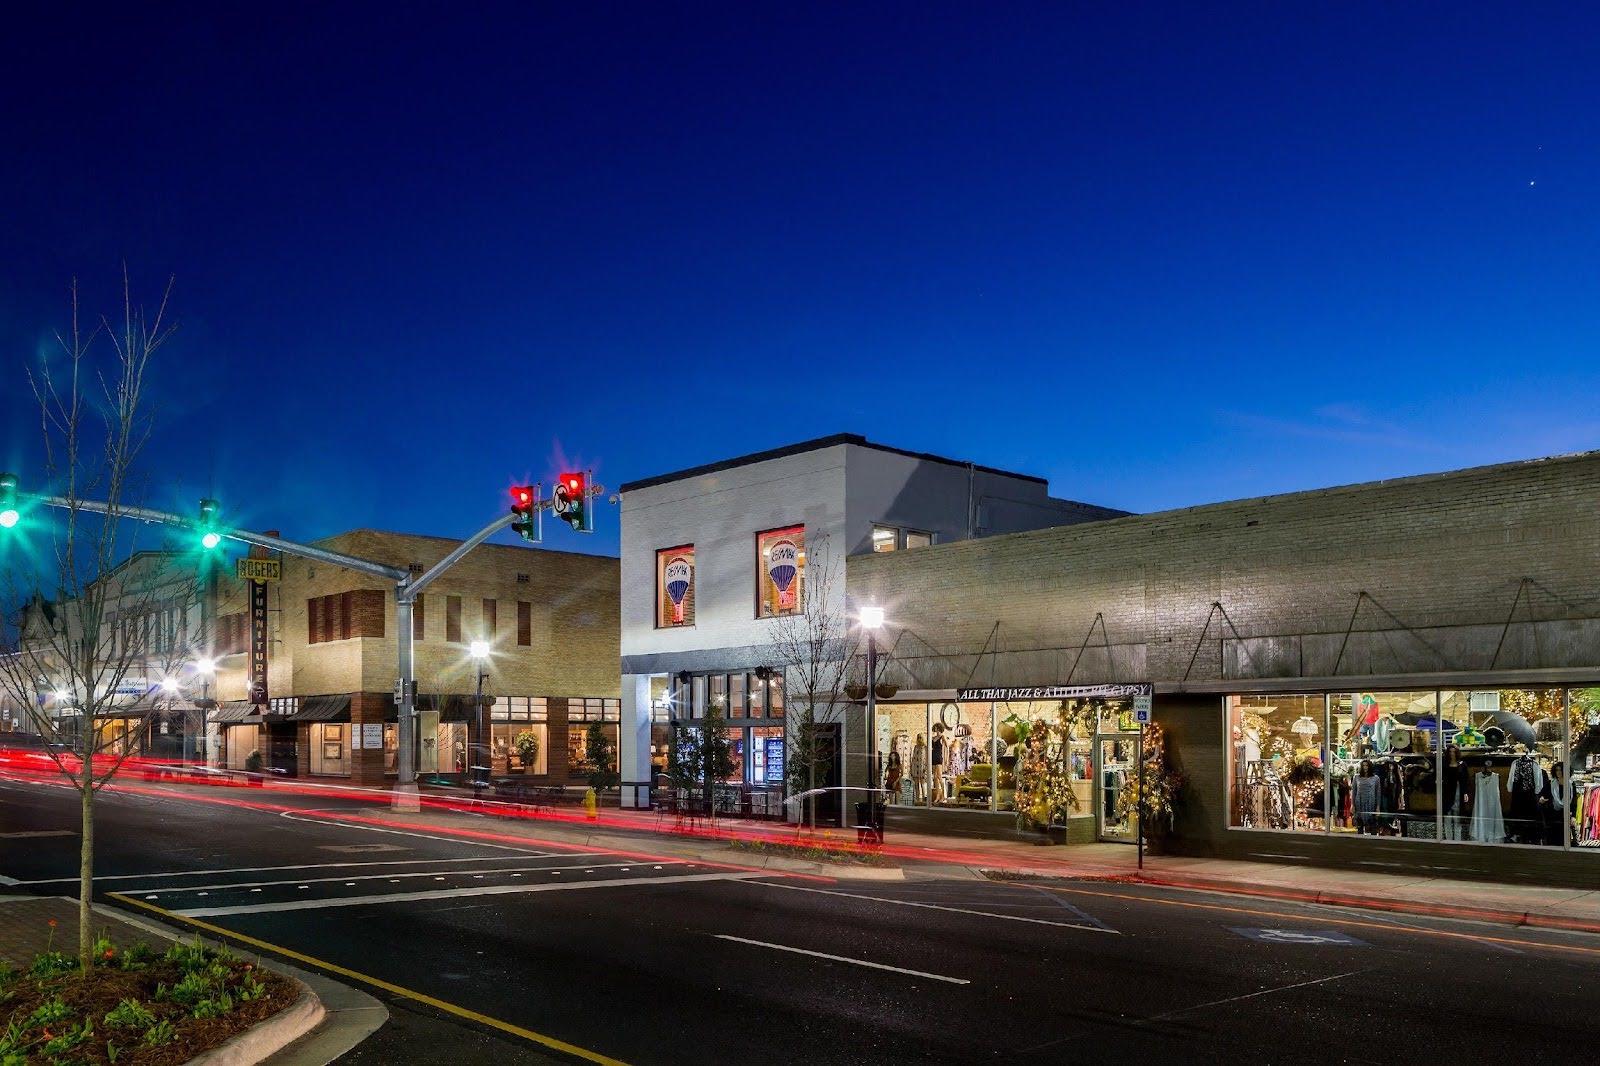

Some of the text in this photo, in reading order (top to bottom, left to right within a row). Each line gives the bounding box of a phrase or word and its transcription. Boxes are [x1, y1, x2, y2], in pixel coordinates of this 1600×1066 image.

[240, 560, 278, 578] ROGERS
[255, 587, 265, 683] FURNITURE
[960, 689, 980, 700] ALL
[981, 688, 1007, 700] THAT
[1007, 688, 1032, 701] JAZZ
[1033, 687, 1042, 698] &
[1043, 687, 1052, 698] A
[1111, 684, 1147, 696] GYPSY
